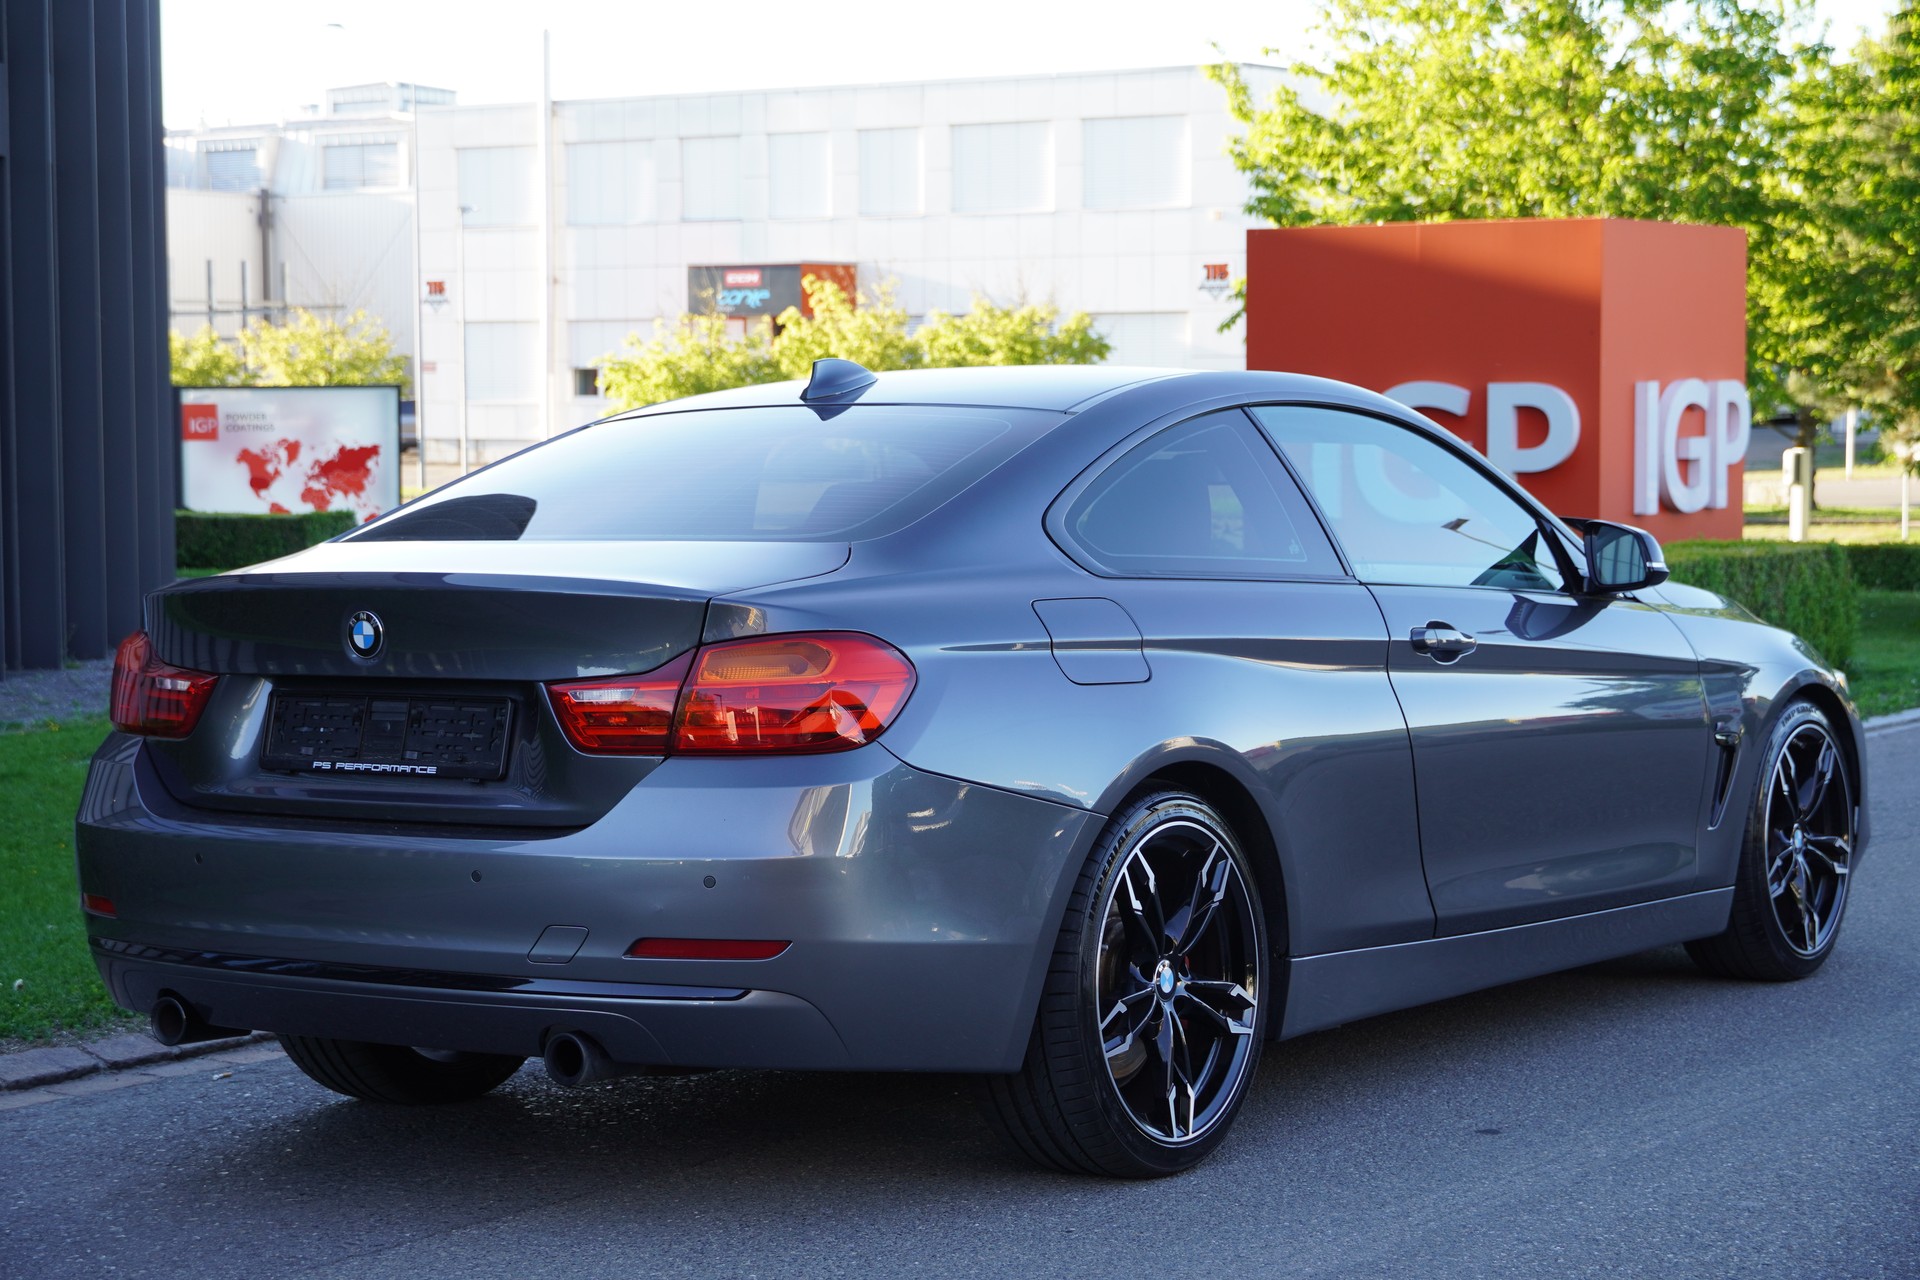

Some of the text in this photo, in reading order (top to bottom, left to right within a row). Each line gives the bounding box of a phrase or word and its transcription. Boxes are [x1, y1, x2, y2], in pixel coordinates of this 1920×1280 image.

[190, 416, 218, 434] IGP
[225, 413, 267, 422] POWDER
[225, 423, 275, 433] COATINGS
[1633, 377, 1752, 516] IGP
[312, 761, 438, 774] PS PERFORMANCE
[1088, 828, 1131, 921] IMPERIAL
